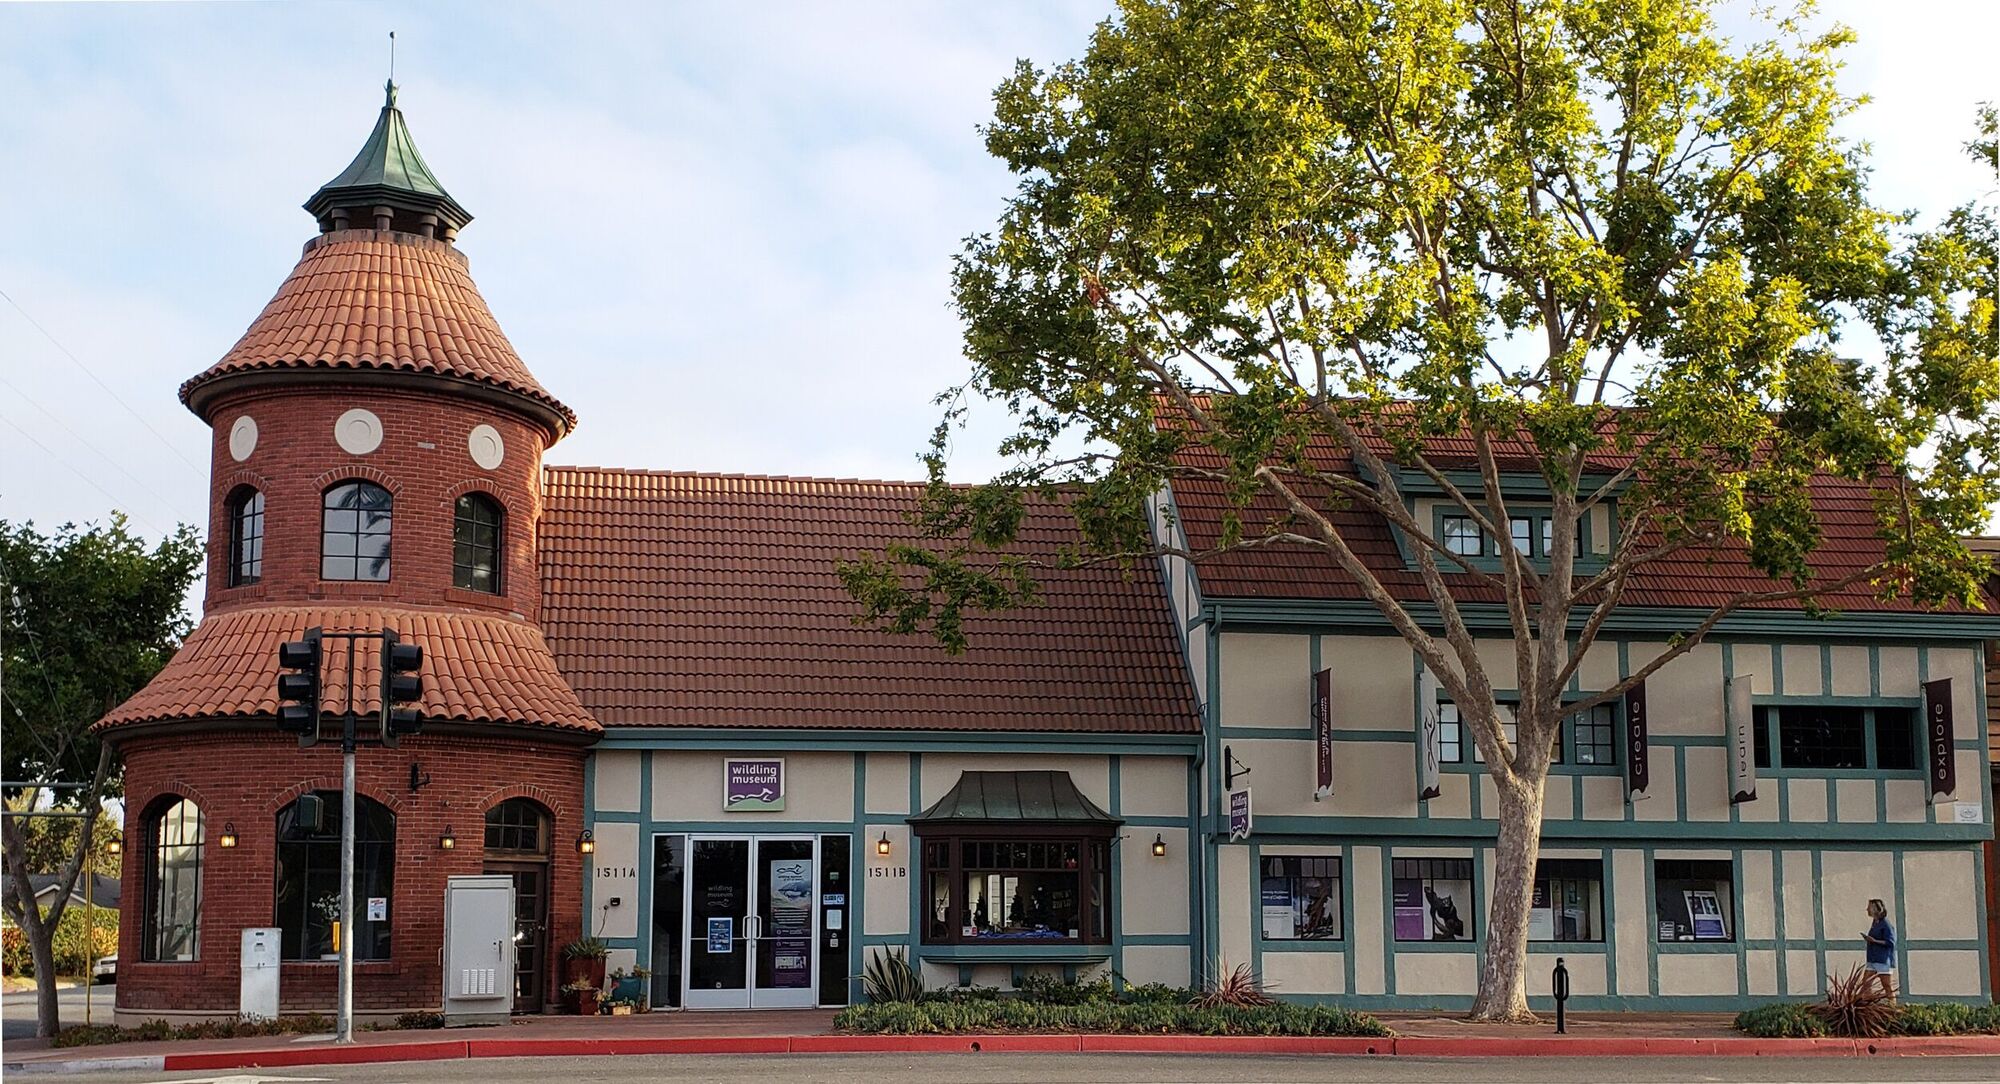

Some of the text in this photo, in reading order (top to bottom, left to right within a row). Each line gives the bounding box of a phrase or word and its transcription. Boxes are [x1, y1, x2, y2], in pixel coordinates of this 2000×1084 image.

[1632, 701, 1642, 775] create
[1935, 703, 1947, 780] explore
[1738, 725, 1747, 778] learn
[732, 764, 777, 777] wildling
[732, 776, 777, 784] museum
[597, 867, 635, 878] 1511A
[869, 867, 906, 878] 1511B
